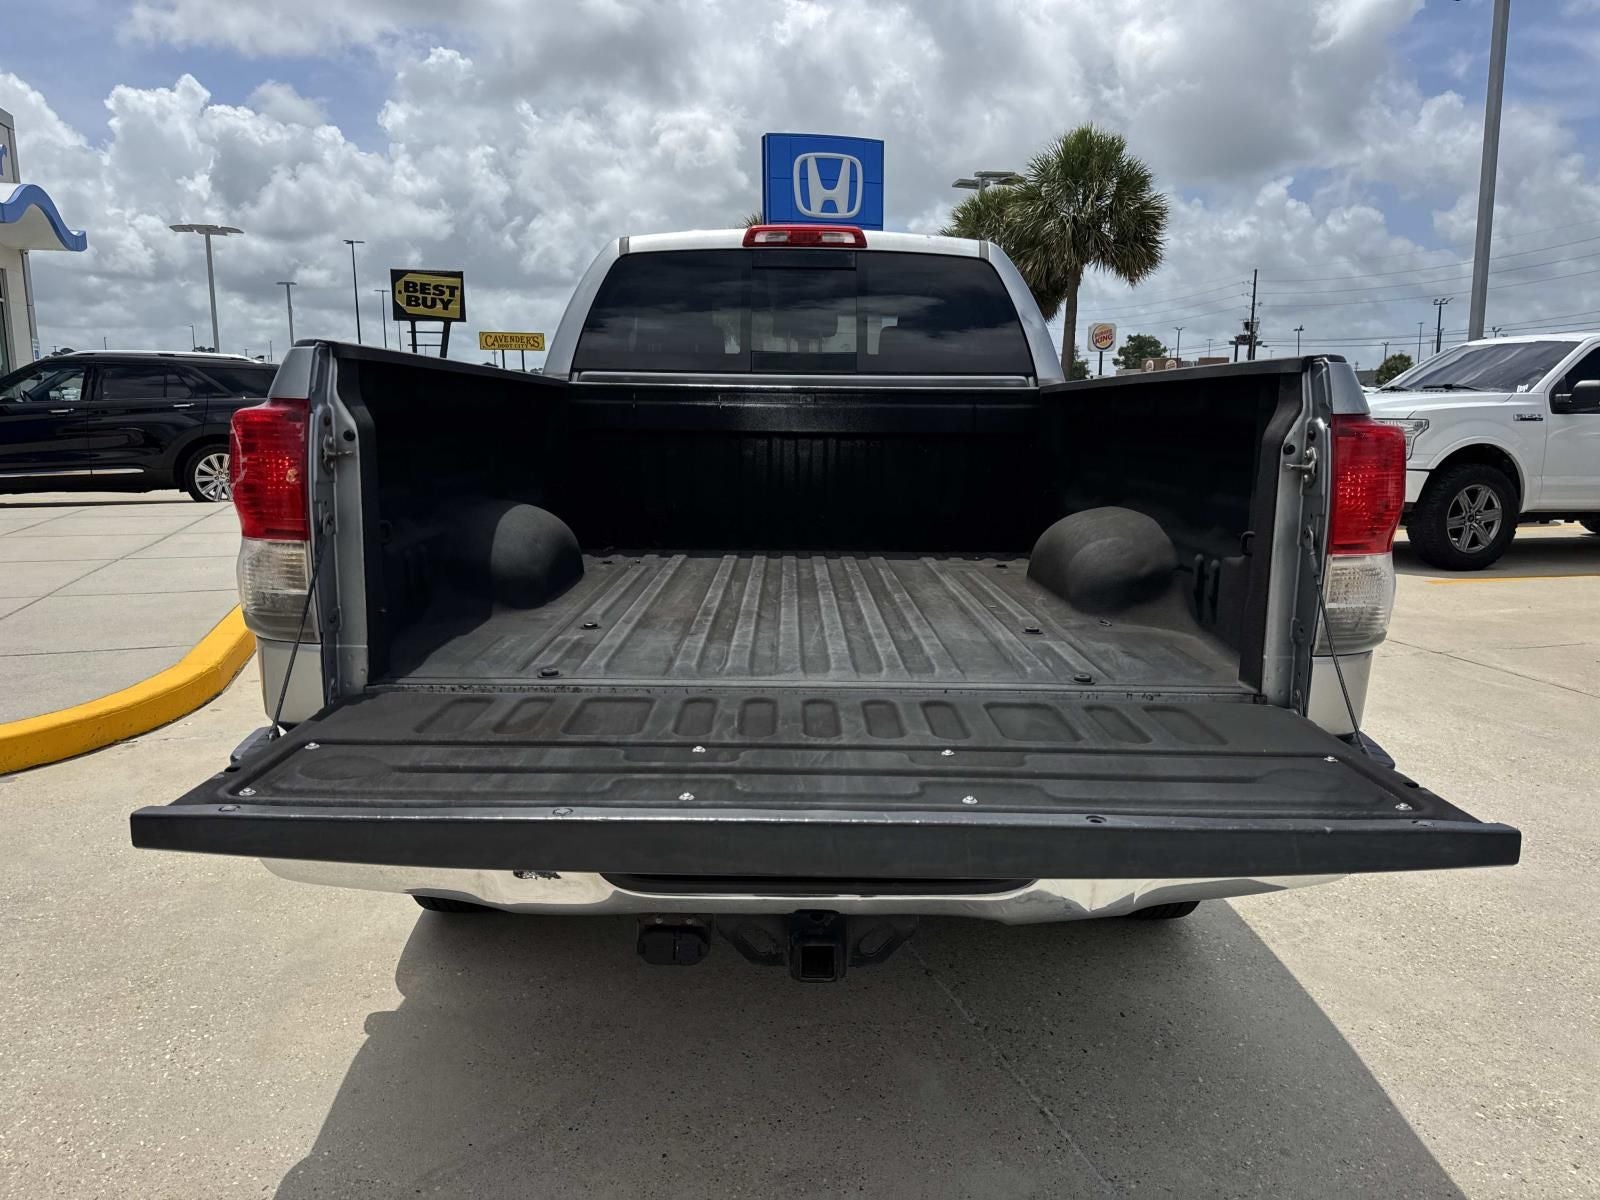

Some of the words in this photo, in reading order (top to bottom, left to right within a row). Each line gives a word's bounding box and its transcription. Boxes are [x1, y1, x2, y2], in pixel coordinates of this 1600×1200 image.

[403, 280, 459, 298] BEST
[405, 294, 454, 311] BUY
[484, 334, 540, 349] CAVENDER'S
